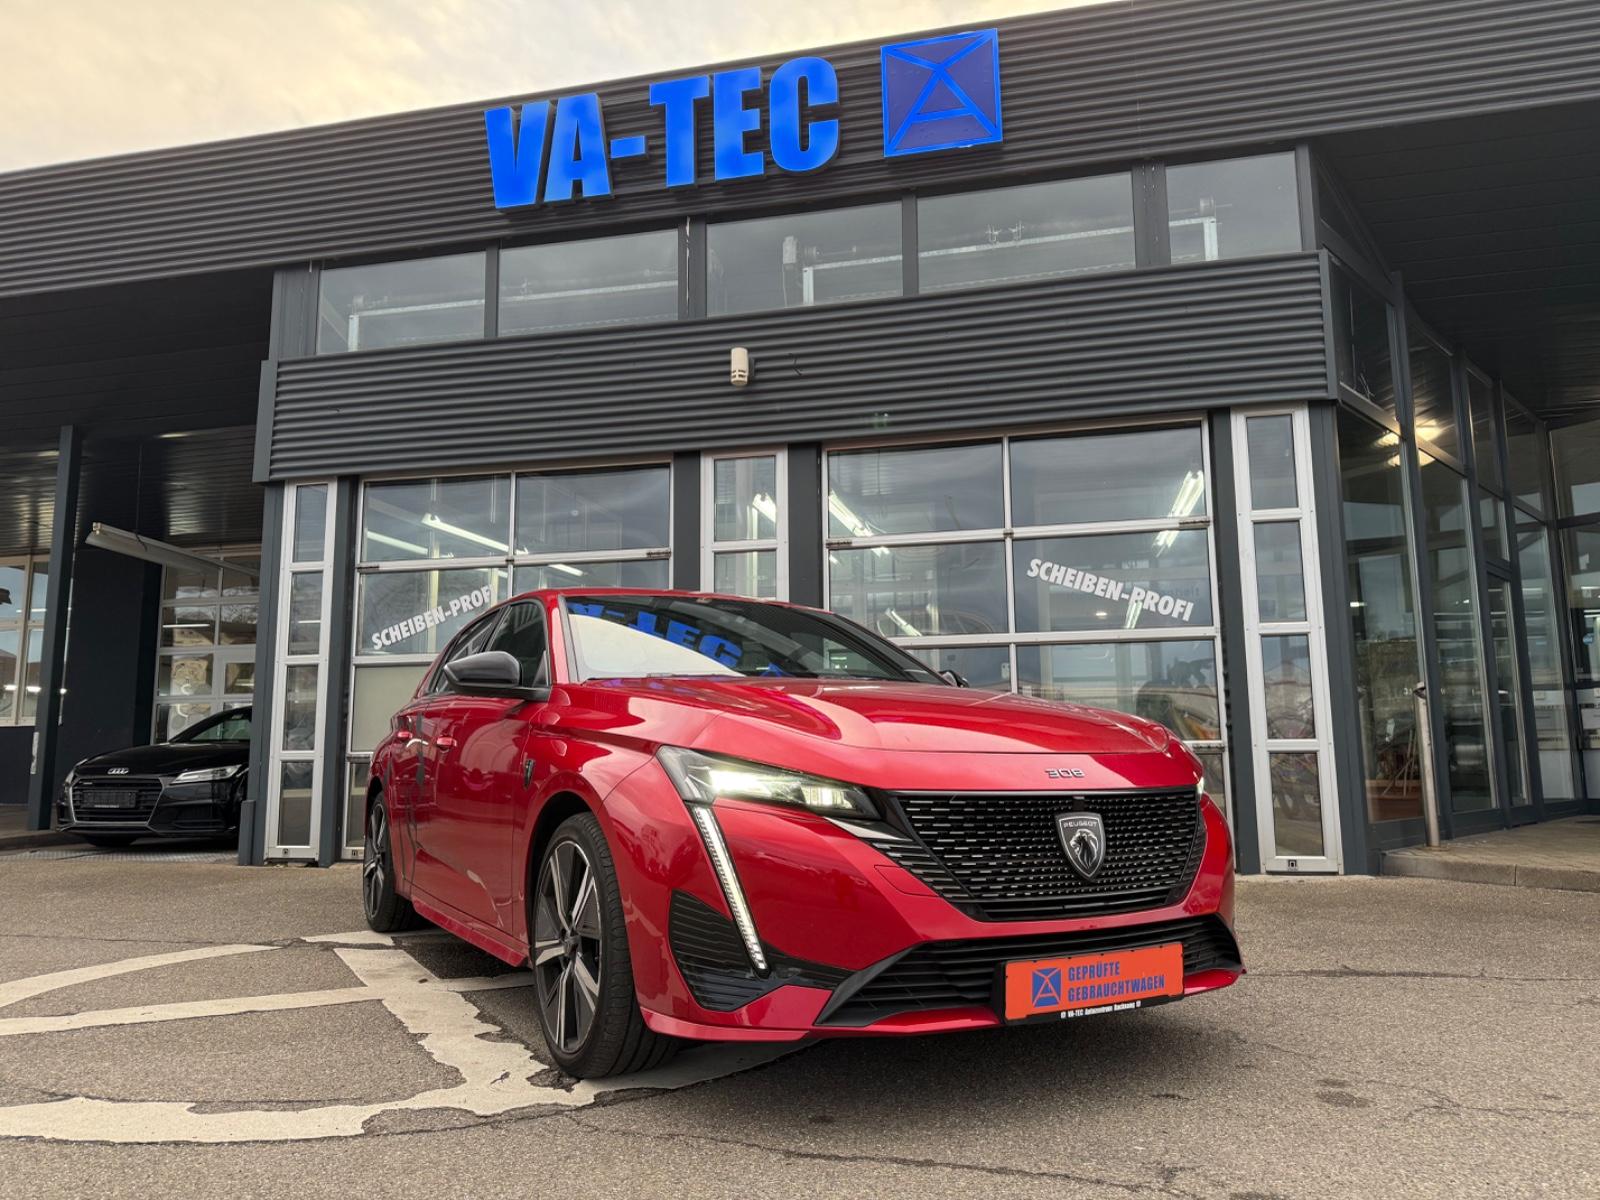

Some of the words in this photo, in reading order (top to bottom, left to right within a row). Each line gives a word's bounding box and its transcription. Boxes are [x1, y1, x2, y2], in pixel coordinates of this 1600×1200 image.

[484, 57, 839, 209] VA-TEC
[1027, 558, 1194, 621] SCHEIBEN-PROFI
[1045, 768, 1085, 779] 308
[1068, 961, 1120, 982] GEPRÜFTE
[1068, 975, 1165, 1002] GEBRAUCHTWAGEN
